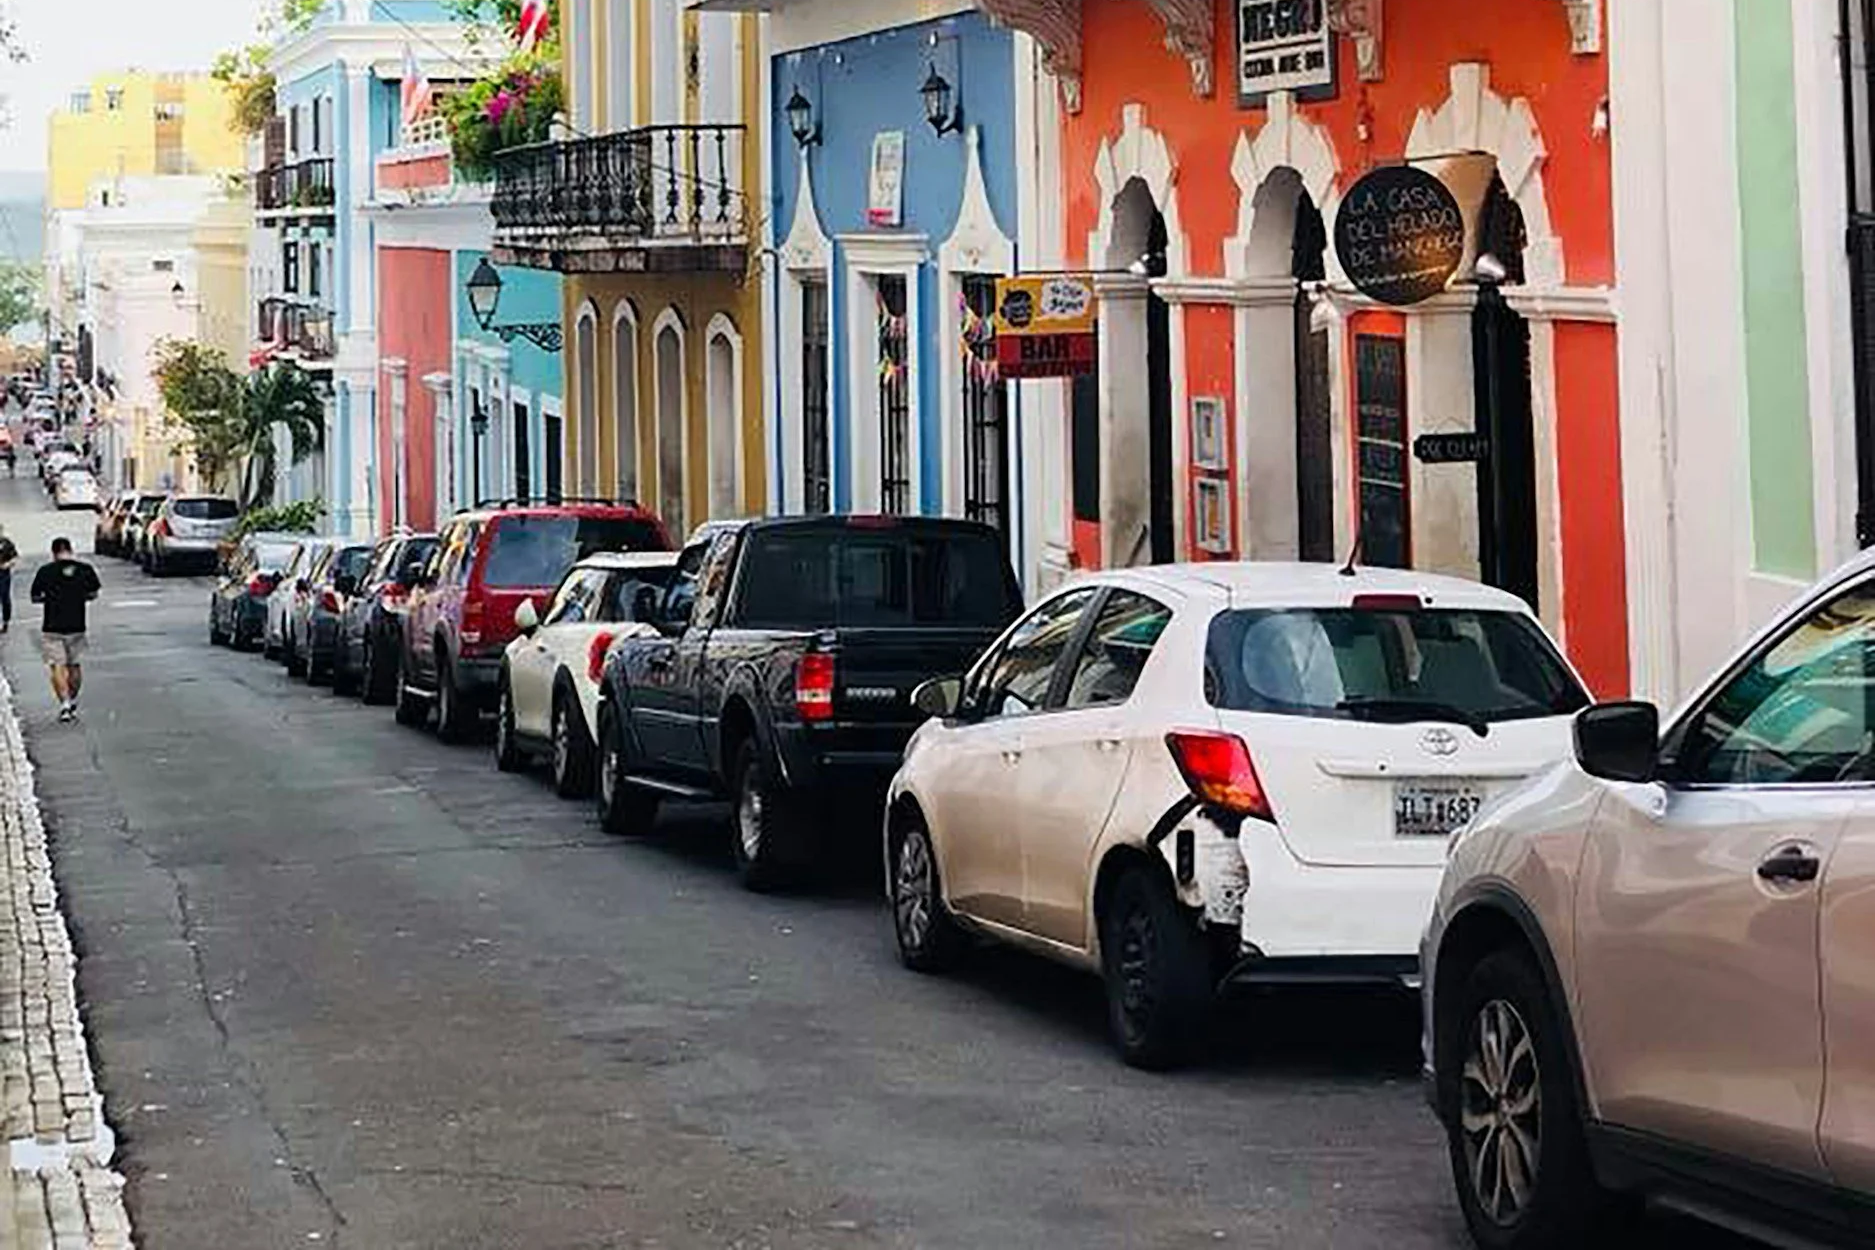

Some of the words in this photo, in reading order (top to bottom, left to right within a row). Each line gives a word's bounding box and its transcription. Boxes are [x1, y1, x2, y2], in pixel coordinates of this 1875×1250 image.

[1387, 186, 1445, 212] CASA
[1347, 216, 1386, 242] DEL
[1020, 334, 1070, 360] BAR
